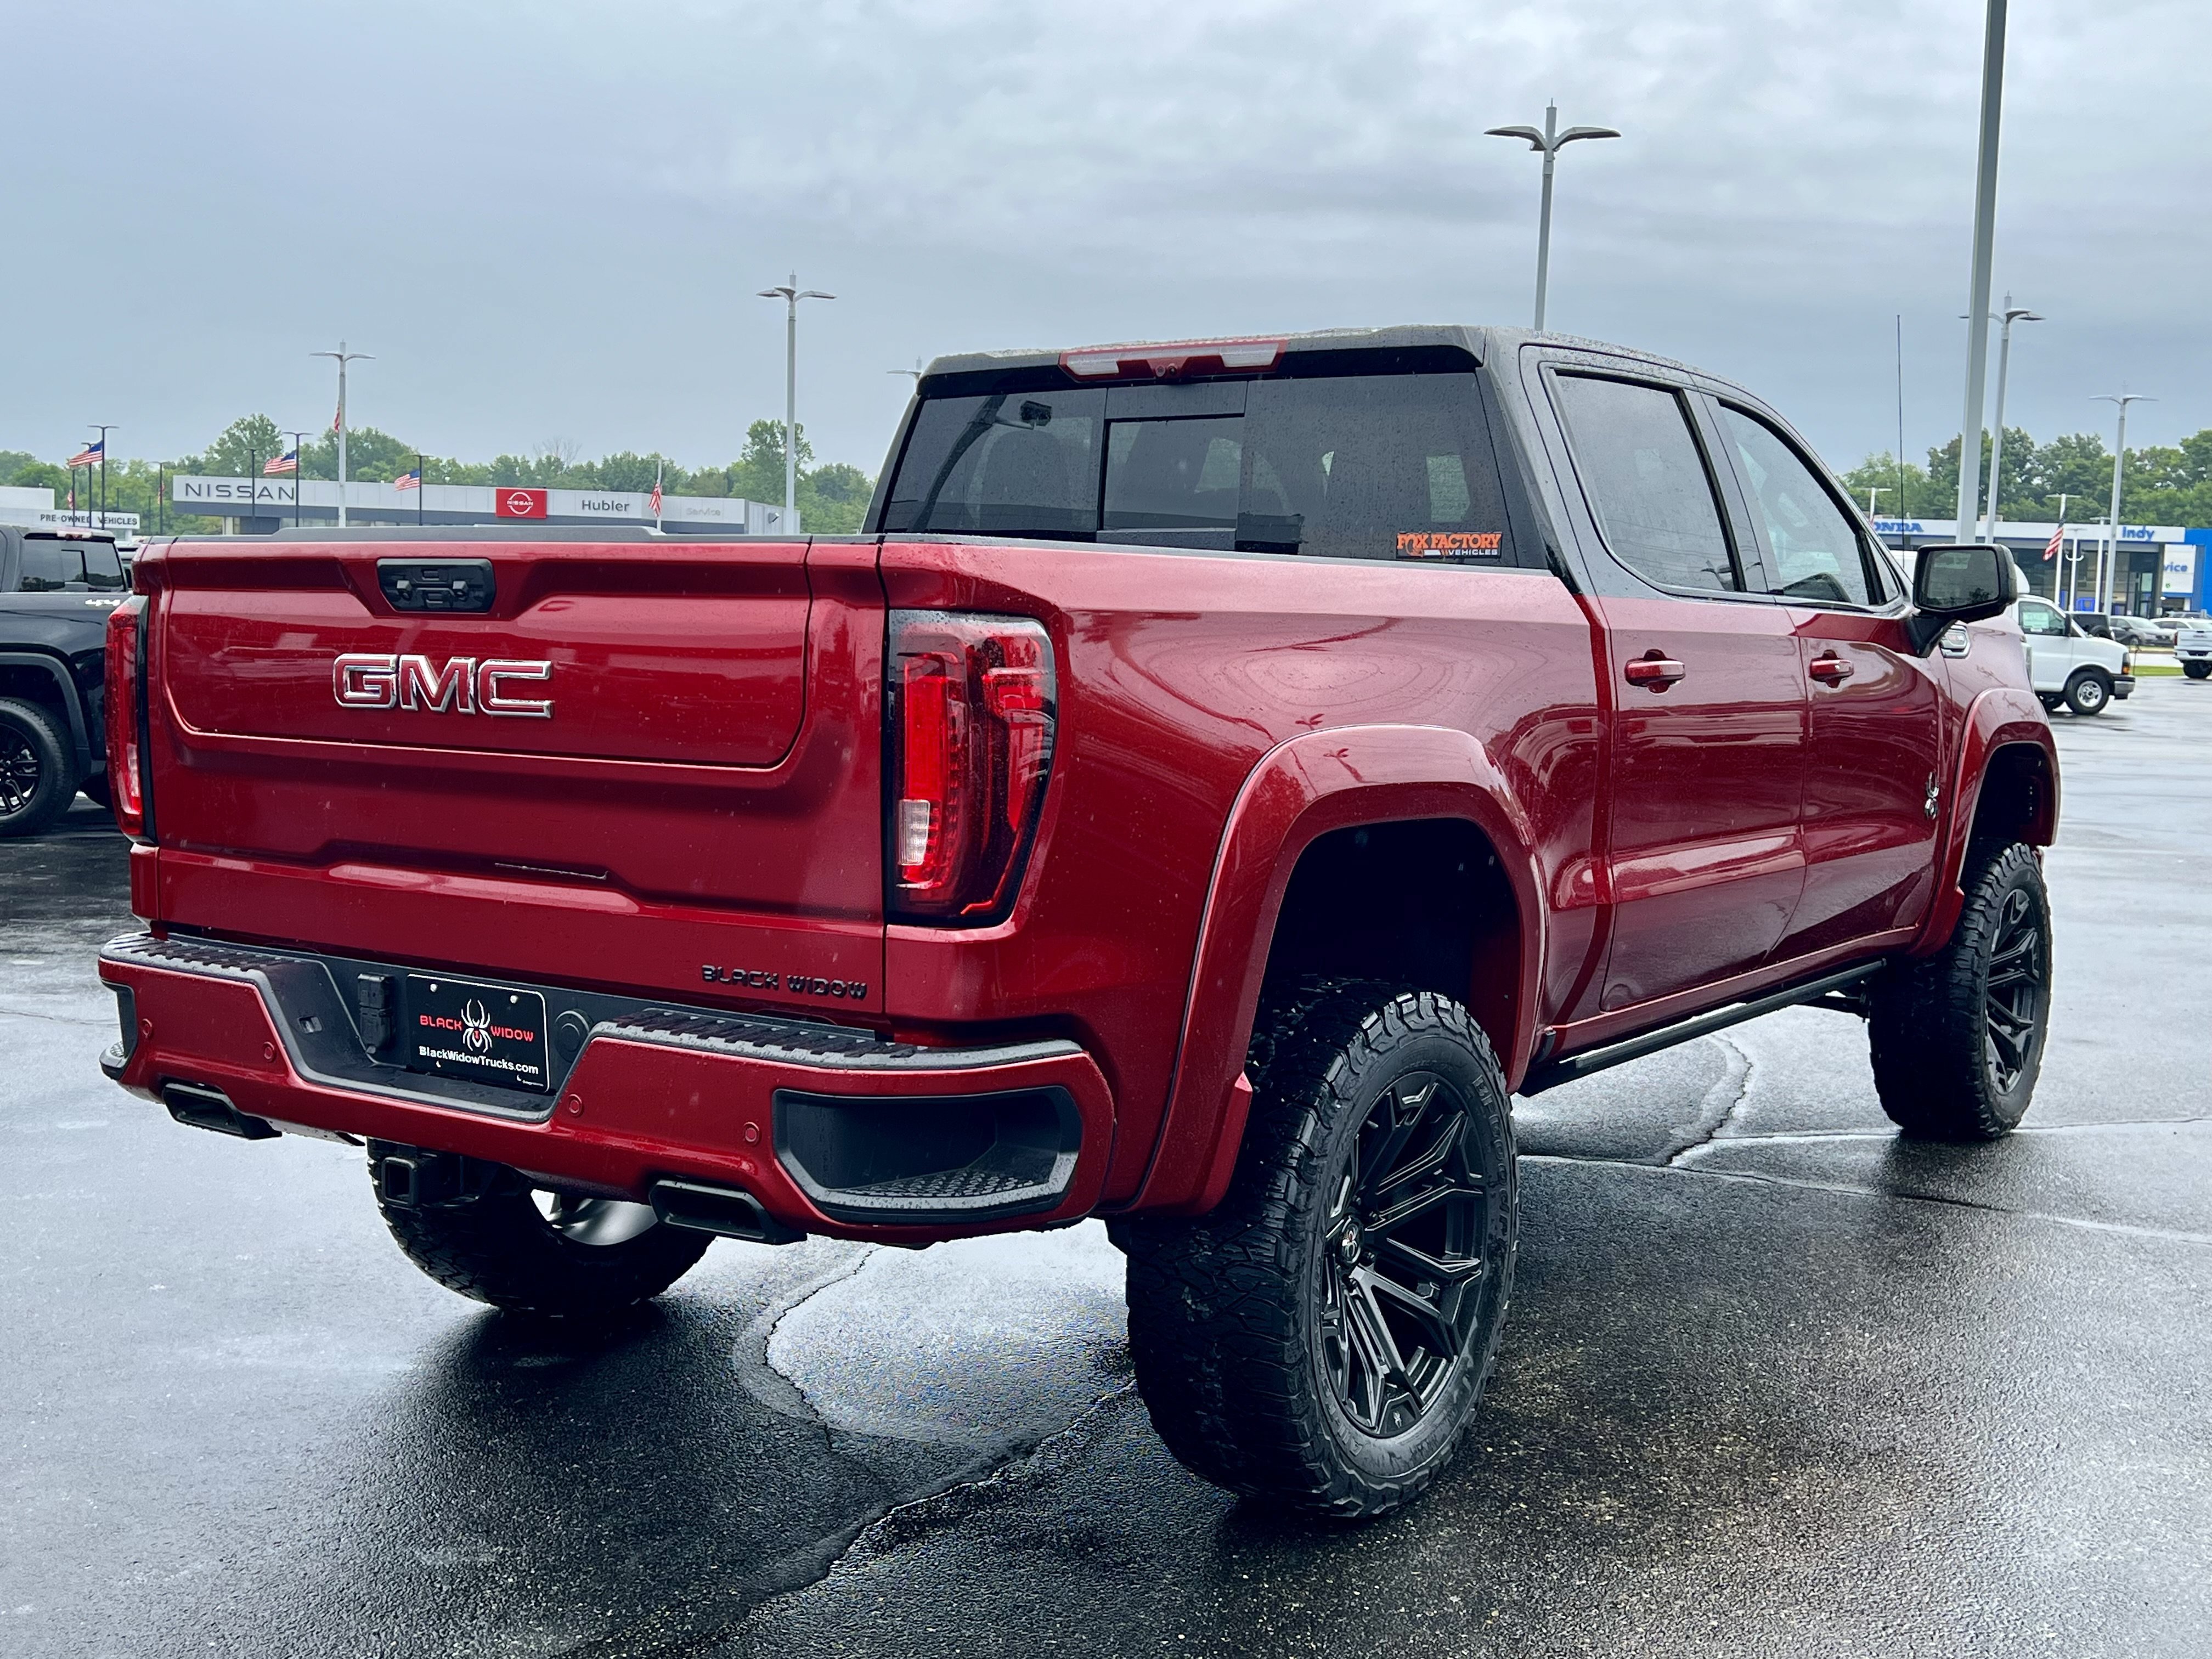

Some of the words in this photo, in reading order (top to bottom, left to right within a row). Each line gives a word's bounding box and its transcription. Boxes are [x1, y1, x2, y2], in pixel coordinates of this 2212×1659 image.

[185, 483, 295, 500] NISSAN
[582, 500, 630, 512] Hubler
[686, 507, 721, 516] Service
[1872, 522, 1924, 532] ONDA
[2122, 525, 2155, 541] Indy
[1397, 533, 1429, 554] FOX
[1430, 533, 1502, 549] FACTORY
[2164, 562, 2188, 572] vice
[333, 653, 555, 719] GMC
[702, 964, 780, 990] BLACK
[786, 974, 868, 1000] WIDOW
[419, 1014, 463, 1031] BLACK
[490, 1025, 534, 1042] WIDOW
[419, 1046, 539, 1075] BlackWidowTrucks.com
